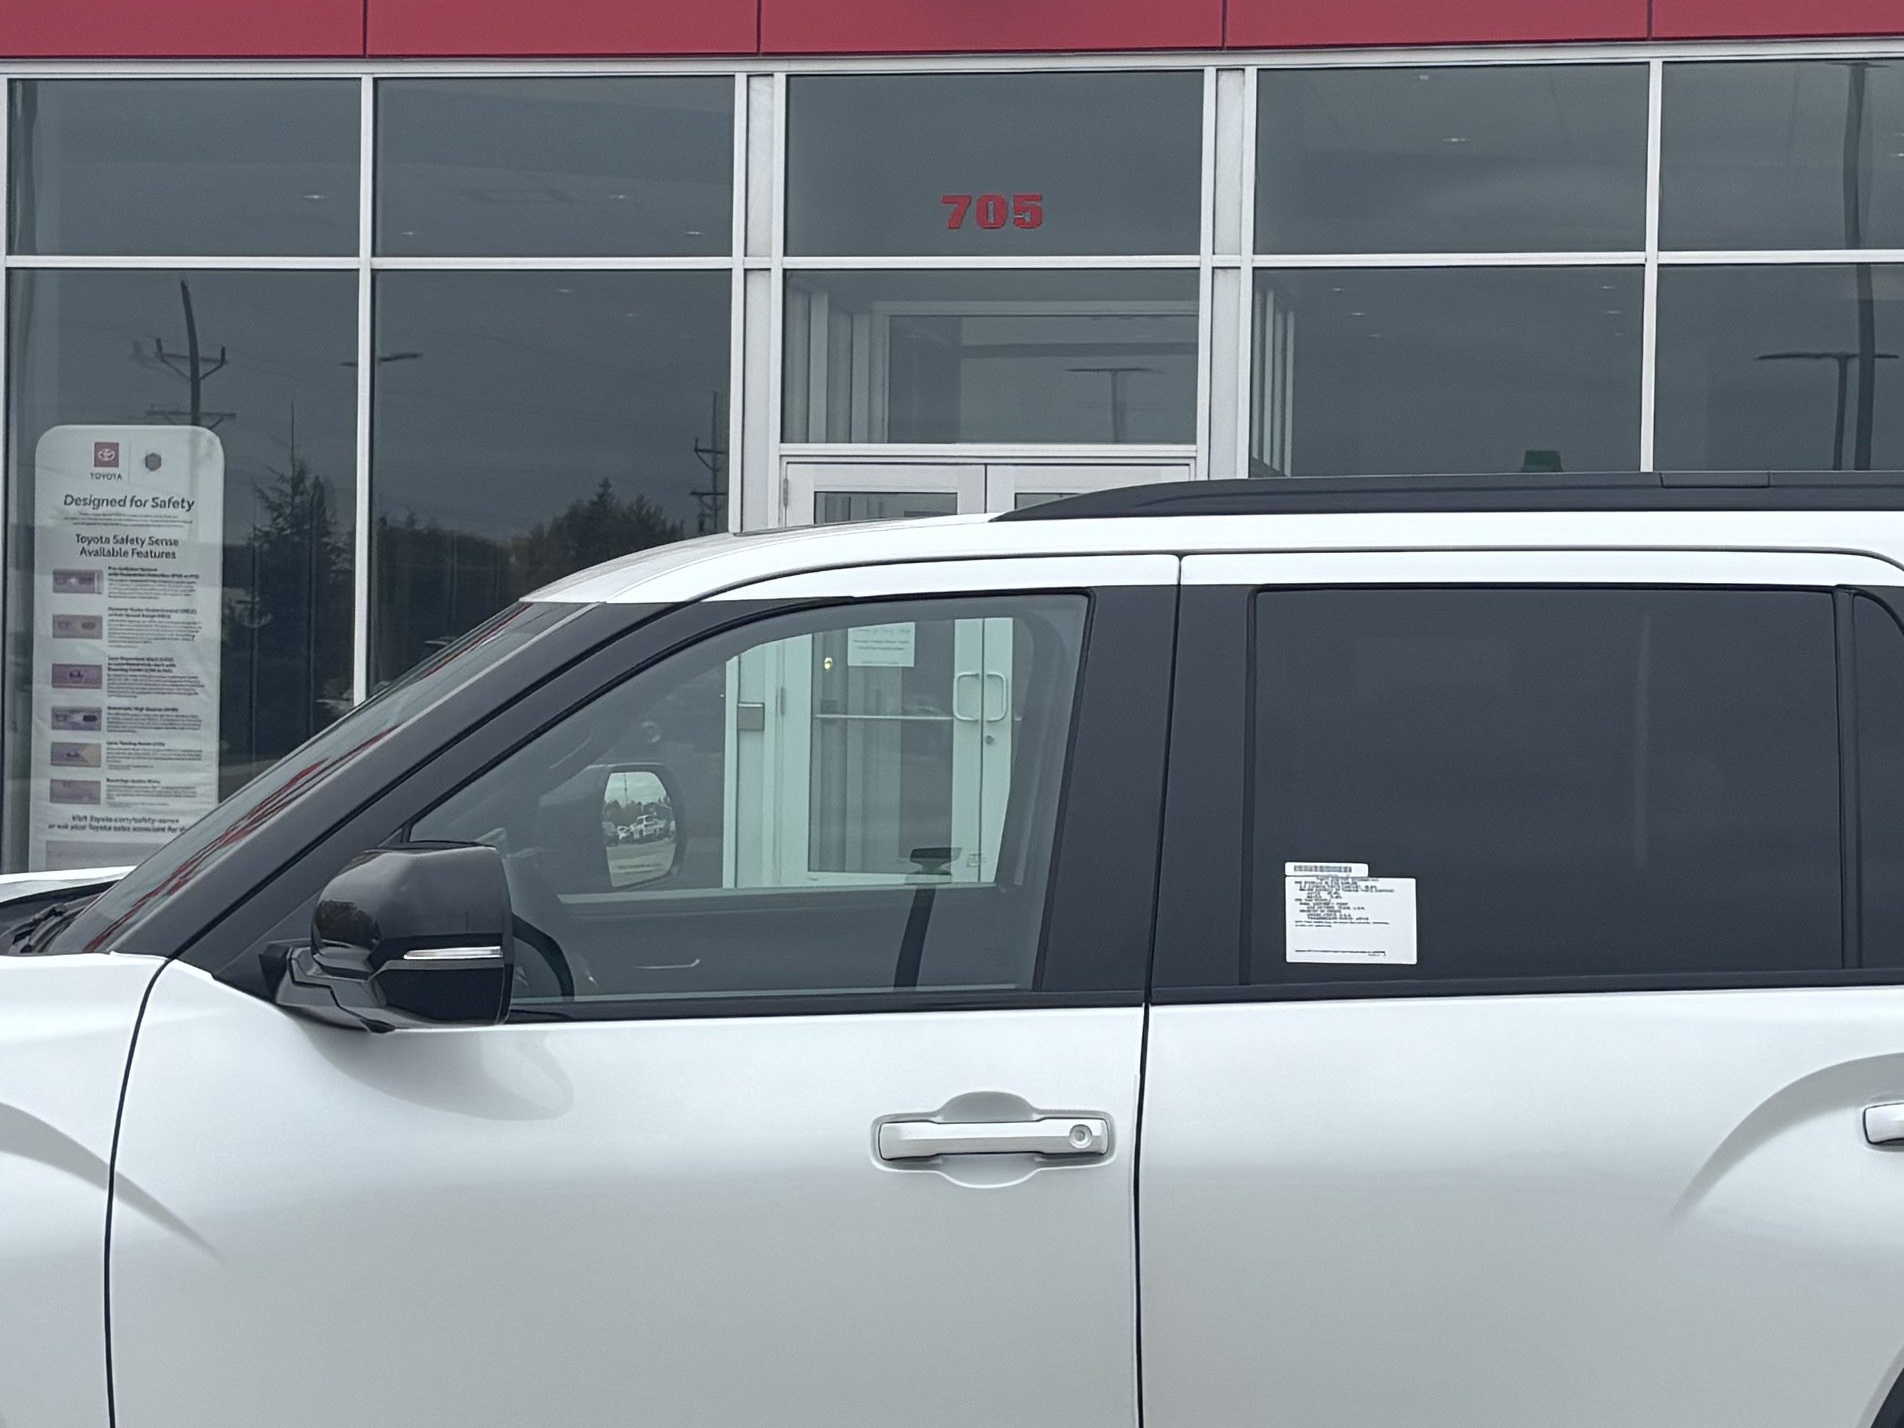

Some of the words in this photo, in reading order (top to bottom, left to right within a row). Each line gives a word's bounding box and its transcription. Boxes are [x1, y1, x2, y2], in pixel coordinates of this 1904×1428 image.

[940, 193, 1044, 230] 705
[90, 472, 123, 480] TOYOTA
[63, 494, 127, 510] Designed
[129, 495, 149, 508] for
[150, 496, 195, 512] Safety
[75, 533, 111, 546] Toyota
[113, 534, 146, 548] Safety
[148, 536, 179, 547] Sense
[79, 546, 129, 558] Available
[131, 548, 177, 559] Features
